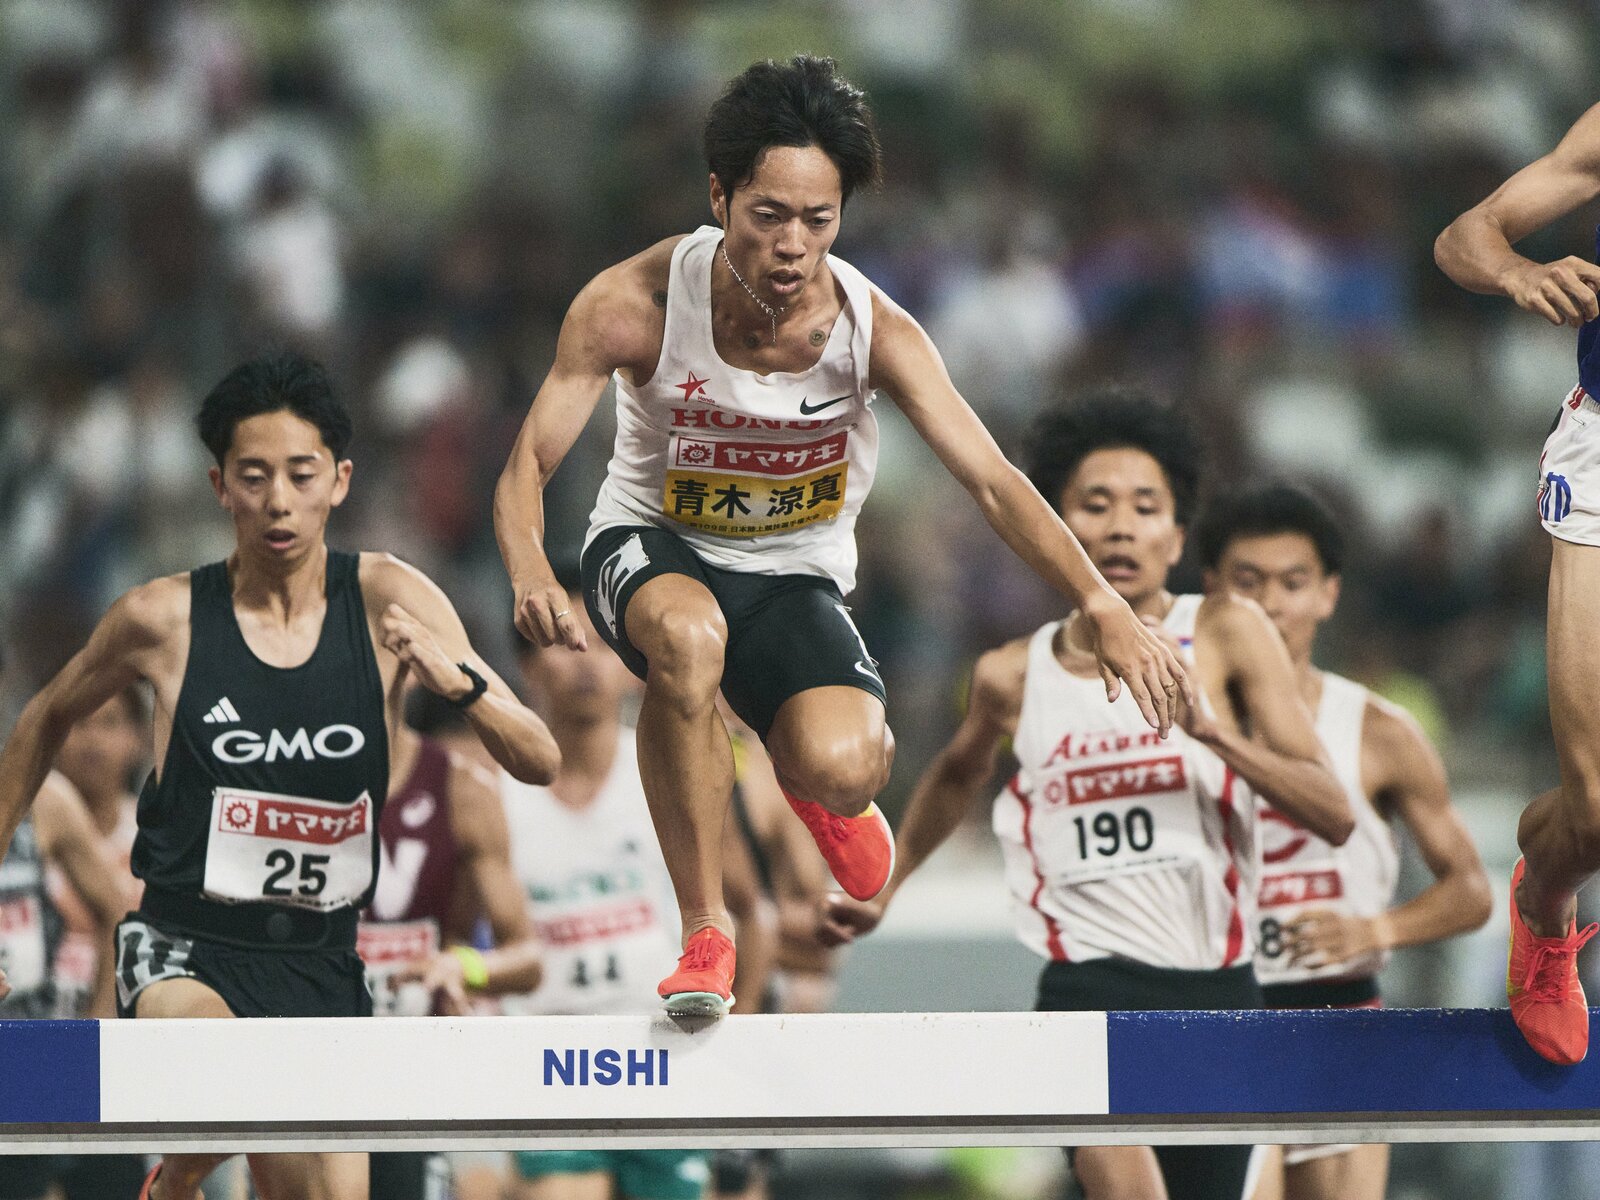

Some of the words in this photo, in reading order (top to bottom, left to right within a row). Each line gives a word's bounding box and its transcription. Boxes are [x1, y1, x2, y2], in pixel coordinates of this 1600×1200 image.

[697, 395, 716, 405] Honda
[670, 408, 843, 431] HOND
[723, 443, 839, 468] ヤマザキ
[671, 479, 752, 519] 青木
[766, 472, 842, 518] 涼真
[211, 723, 366, 764] GMO
[264, 807, 362, 839] ヤマザキ
[1073, 806, 1154, 860] 190
[262, 848, 331, 897] 25
[543, 1048, 669, 1086] NISHI
